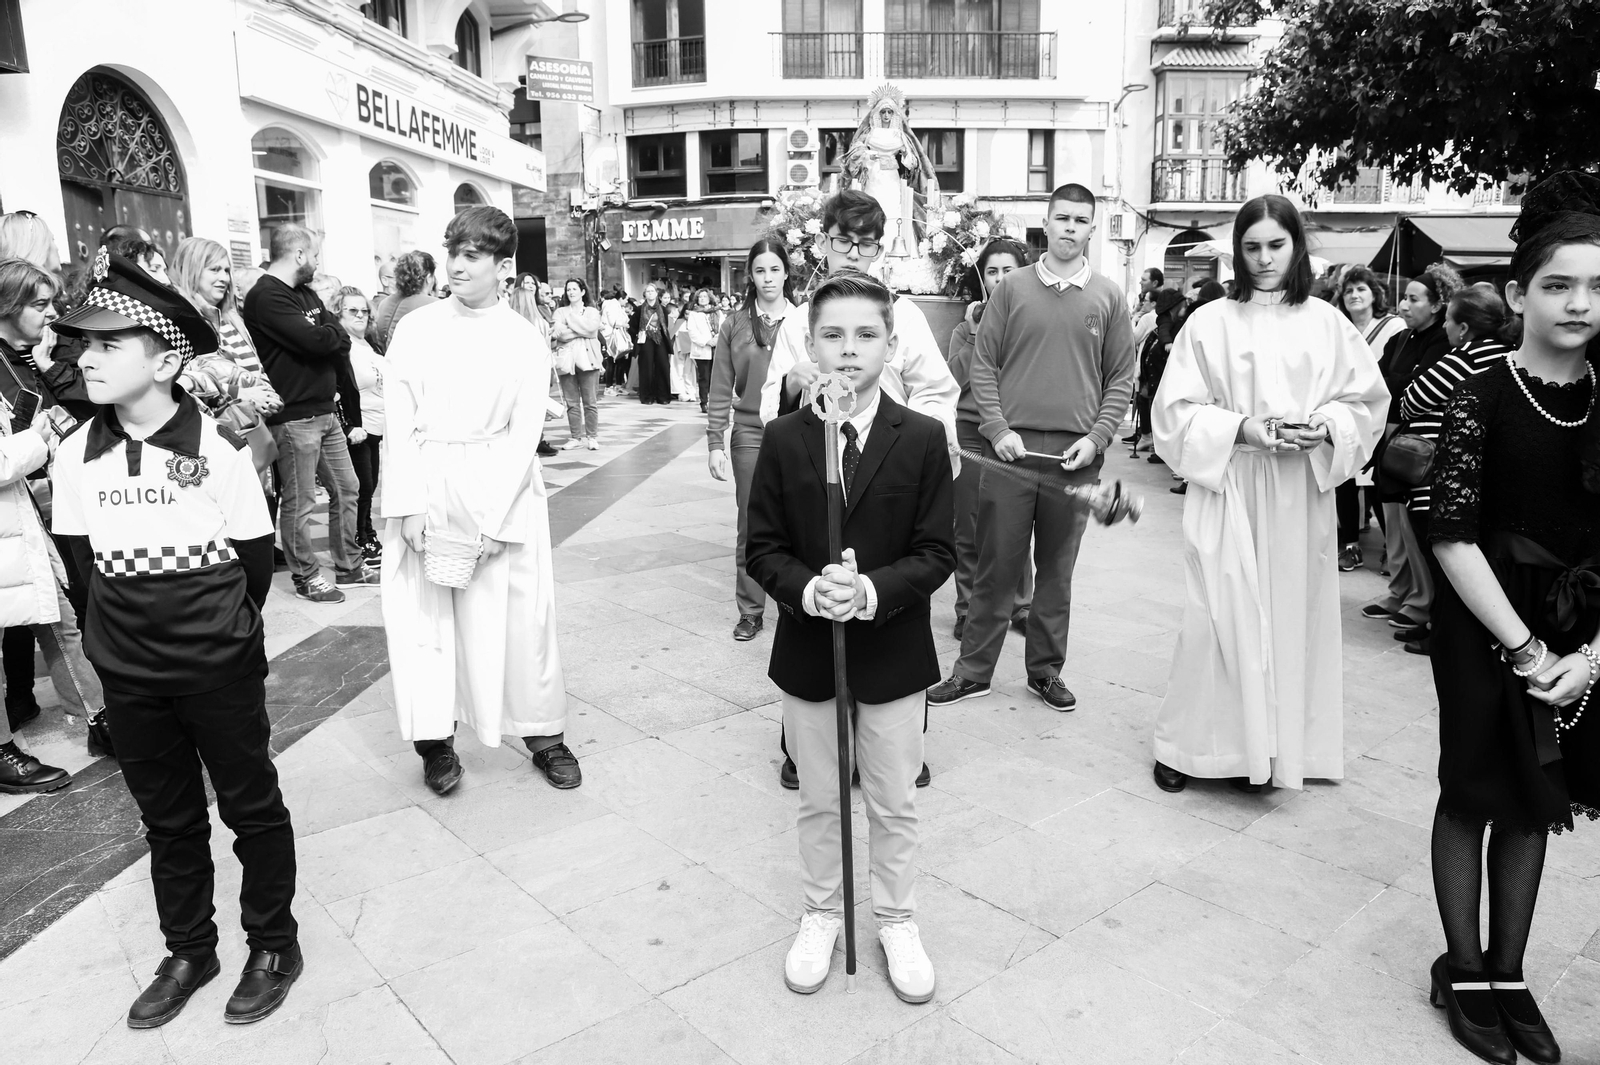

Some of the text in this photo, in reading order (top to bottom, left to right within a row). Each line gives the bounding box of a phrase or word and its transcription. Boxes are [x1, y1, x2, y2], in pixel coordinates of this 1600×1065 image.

[529, 61, 590, 76] ASESORÍA
[529, 73, 559, 82] CANALEJO
[565, 76, 592, 84] CALVENTE
[530, 90, 544, 98] Tel.
[546, 91, 560, 99] 956
[356, 82, 478, 161] BELLAFEMME
[480, 155, 491, 165] LOVE
[621, 217, 705, 242] FEMME
[98, 486, 178, 507] POLICÍA
